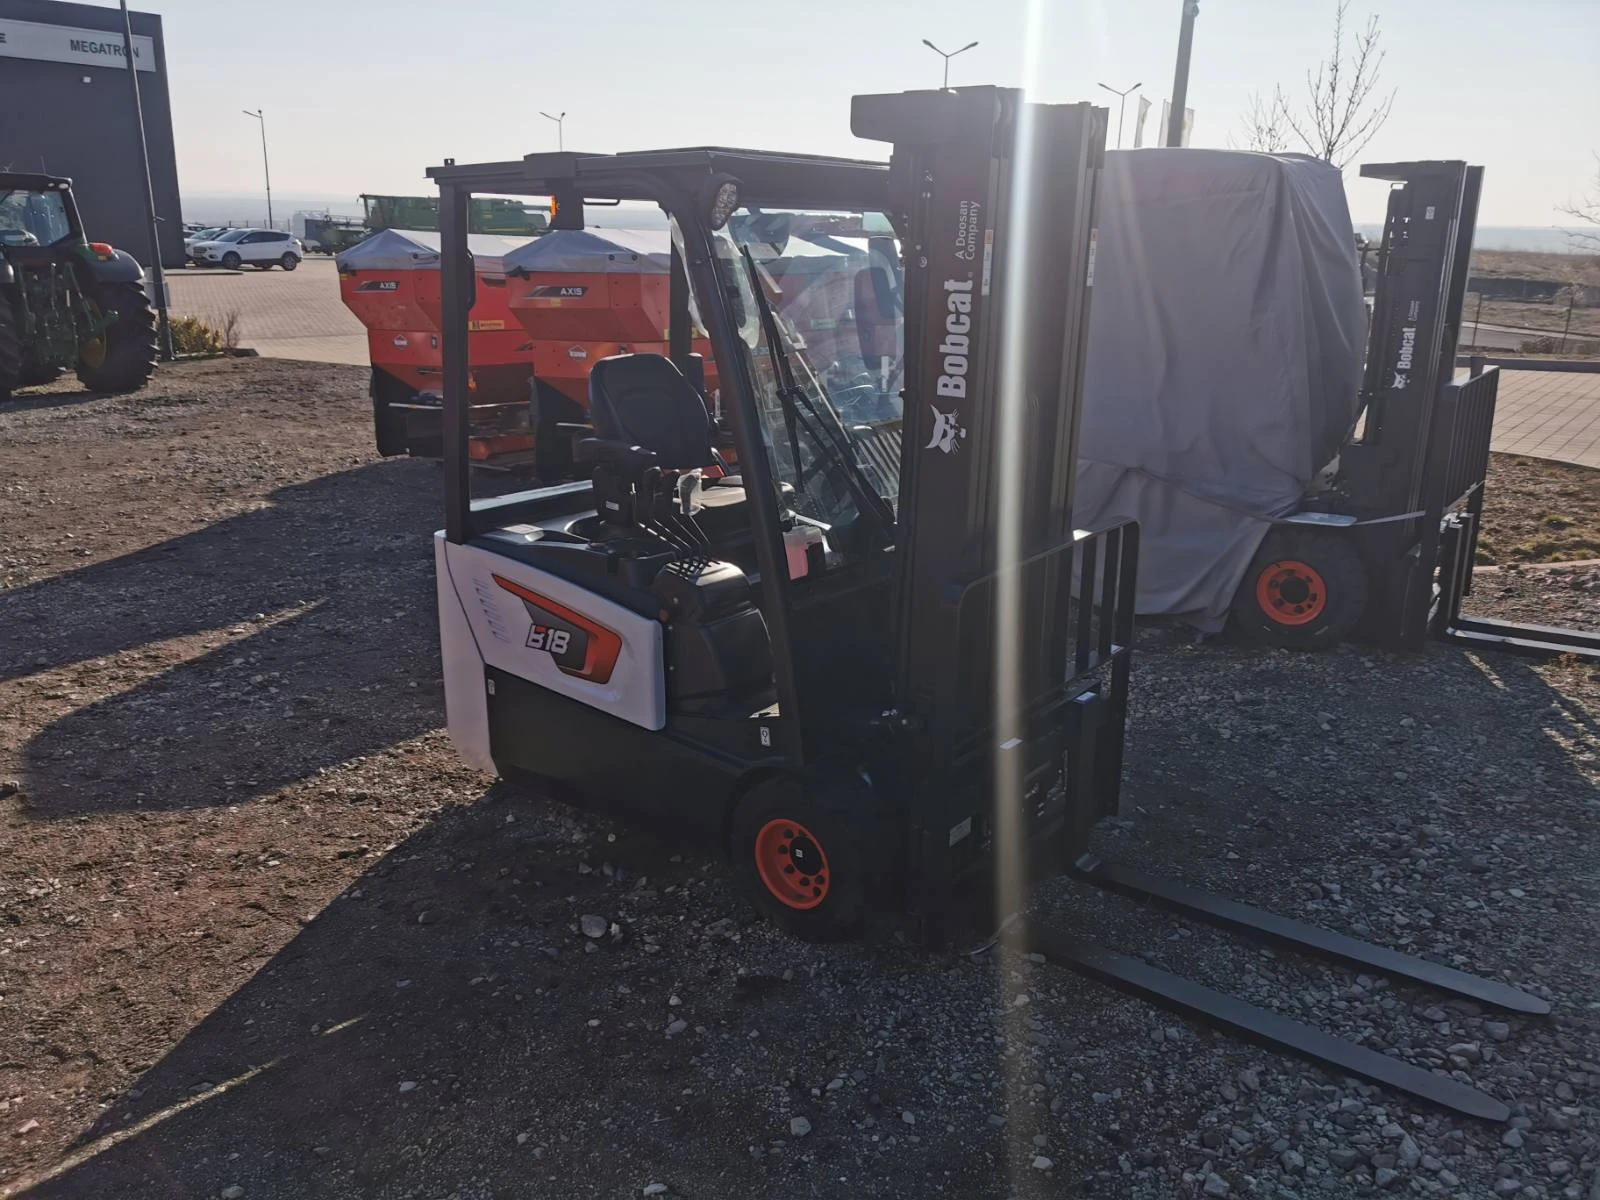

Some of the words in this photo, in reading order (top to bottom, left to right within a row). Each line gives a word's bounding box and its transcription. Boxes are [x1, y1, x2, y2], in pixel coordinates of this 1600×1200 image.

[955, 200, 968, 247] Doosan
[964, 201, 981, 260] Company
[954, 250, 965, 260] A
[380, 281, 397, 289] AXIS
[560, 287, 583, 296] AXIS
[936, 279, 973, 399] Bobcat
[1397, 327, 1416, 369] Bobcat
[526, 624, 571, 655] B18
